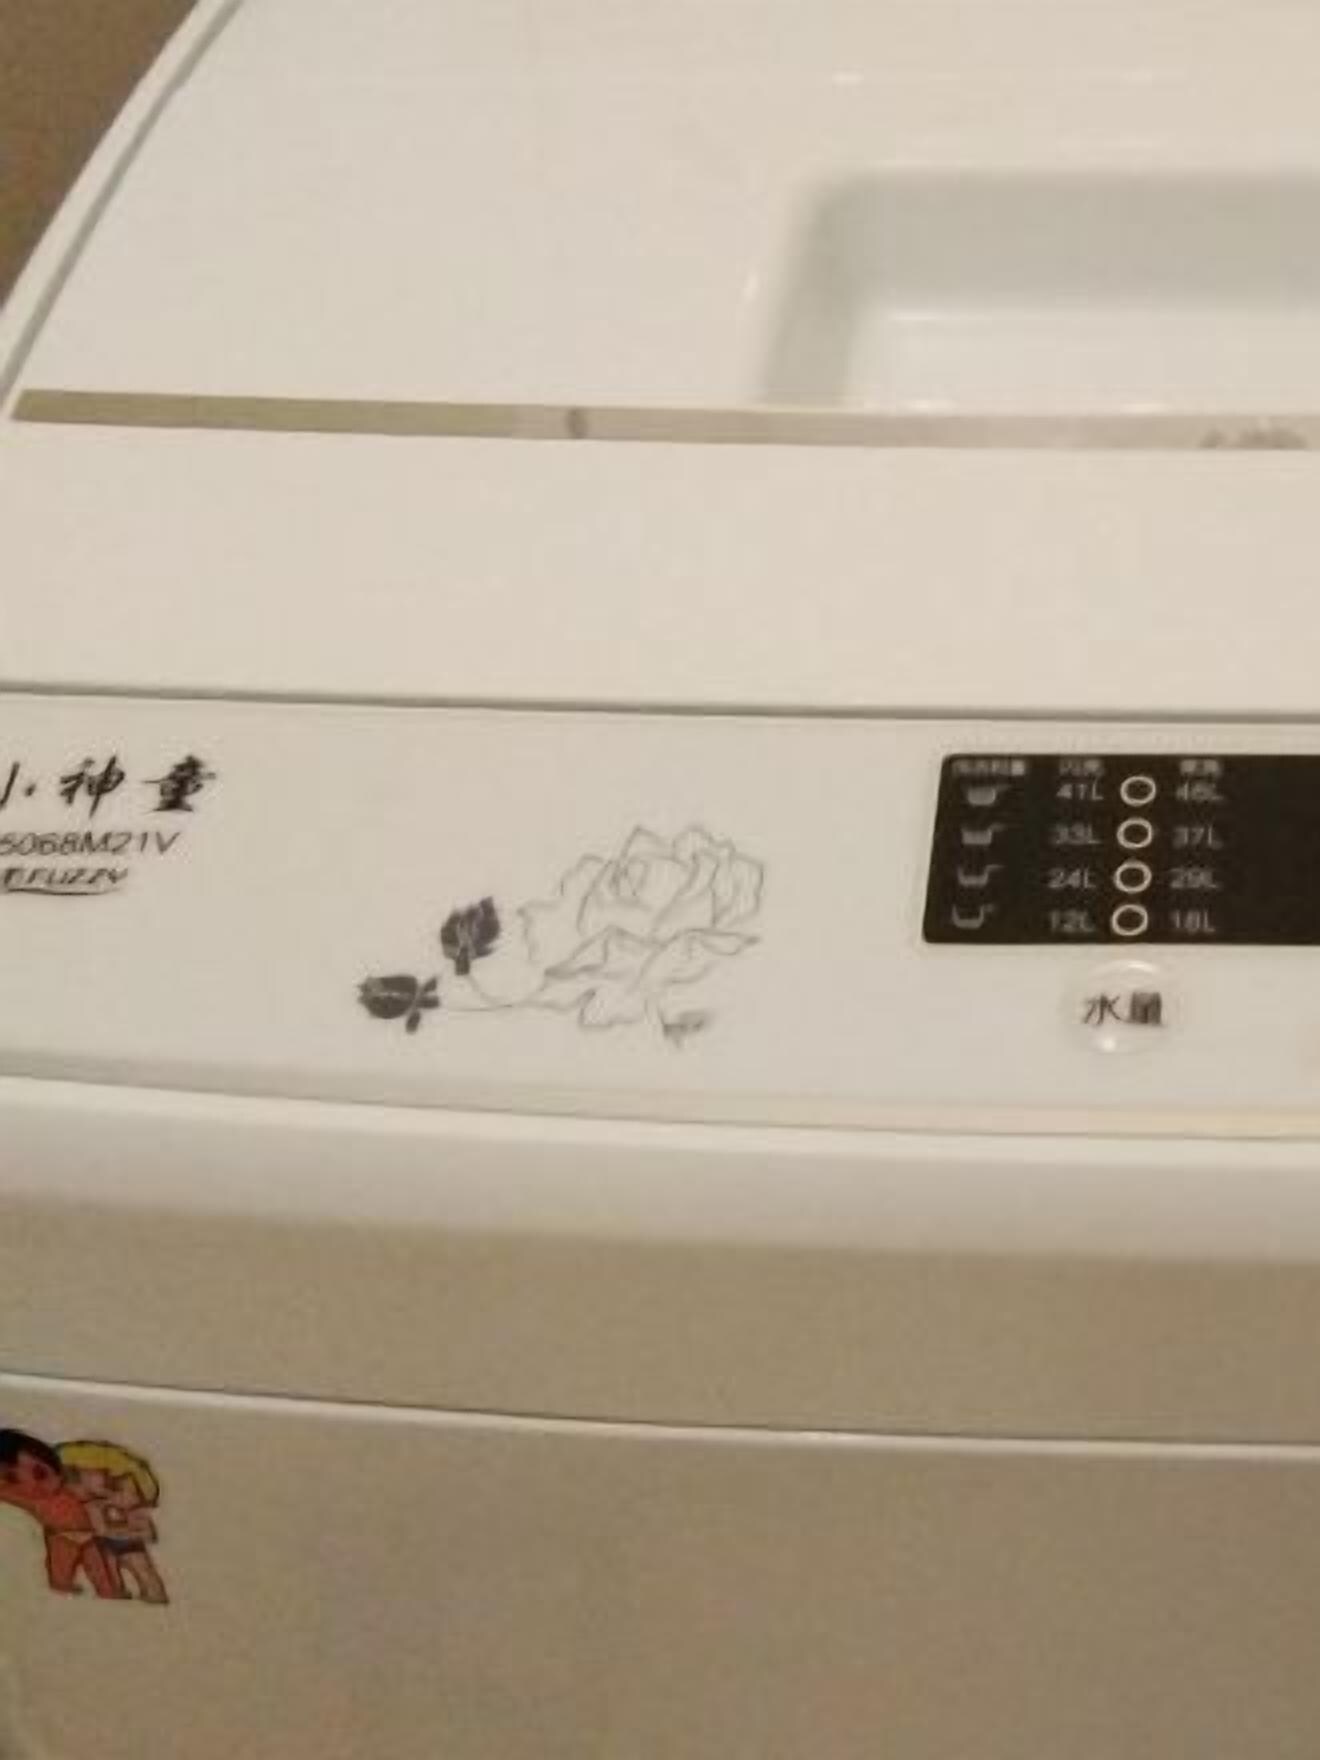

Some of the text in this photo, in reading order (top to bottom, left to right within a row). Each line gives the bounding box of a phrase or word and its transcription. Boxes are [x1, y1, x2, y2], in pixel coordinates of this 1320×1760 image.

[1056, 783, 1103, 801] 41L
[1048, 868, 1096, 890] 24L
[1083, 991, 1165, 1026] 水量
